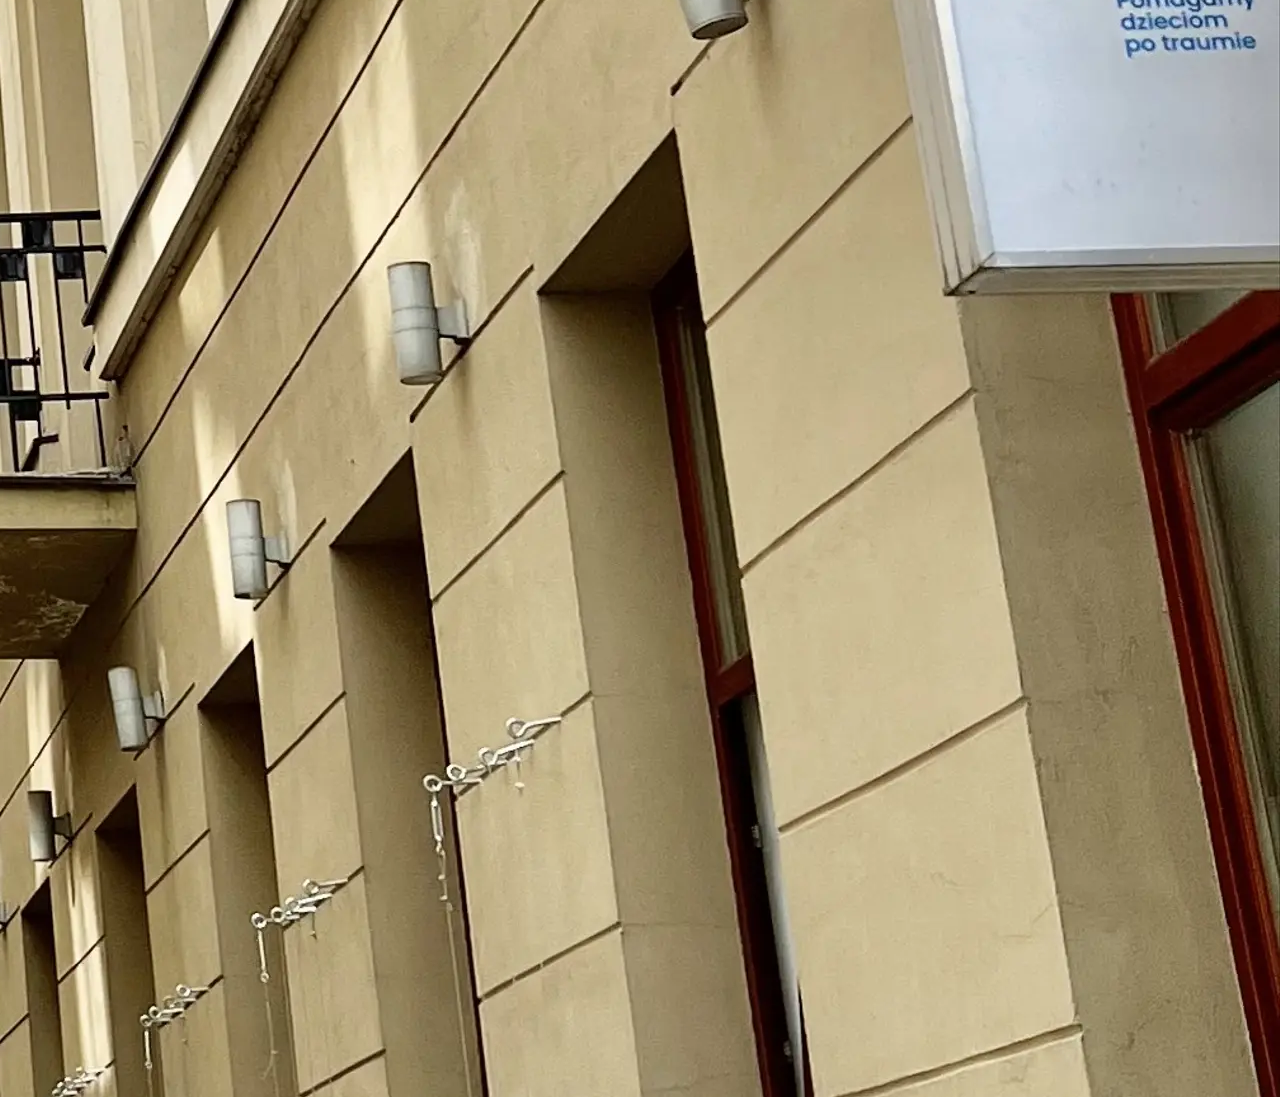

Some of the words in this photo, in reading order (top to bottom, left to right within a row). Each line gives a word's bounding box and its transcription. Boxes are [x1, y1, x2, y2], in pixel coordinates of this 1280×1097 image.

[1120, 12, 1228, 31] dzieciom
[1125, 37, 1156, 58] po
[1161, 32, 1256, 51] traumie
